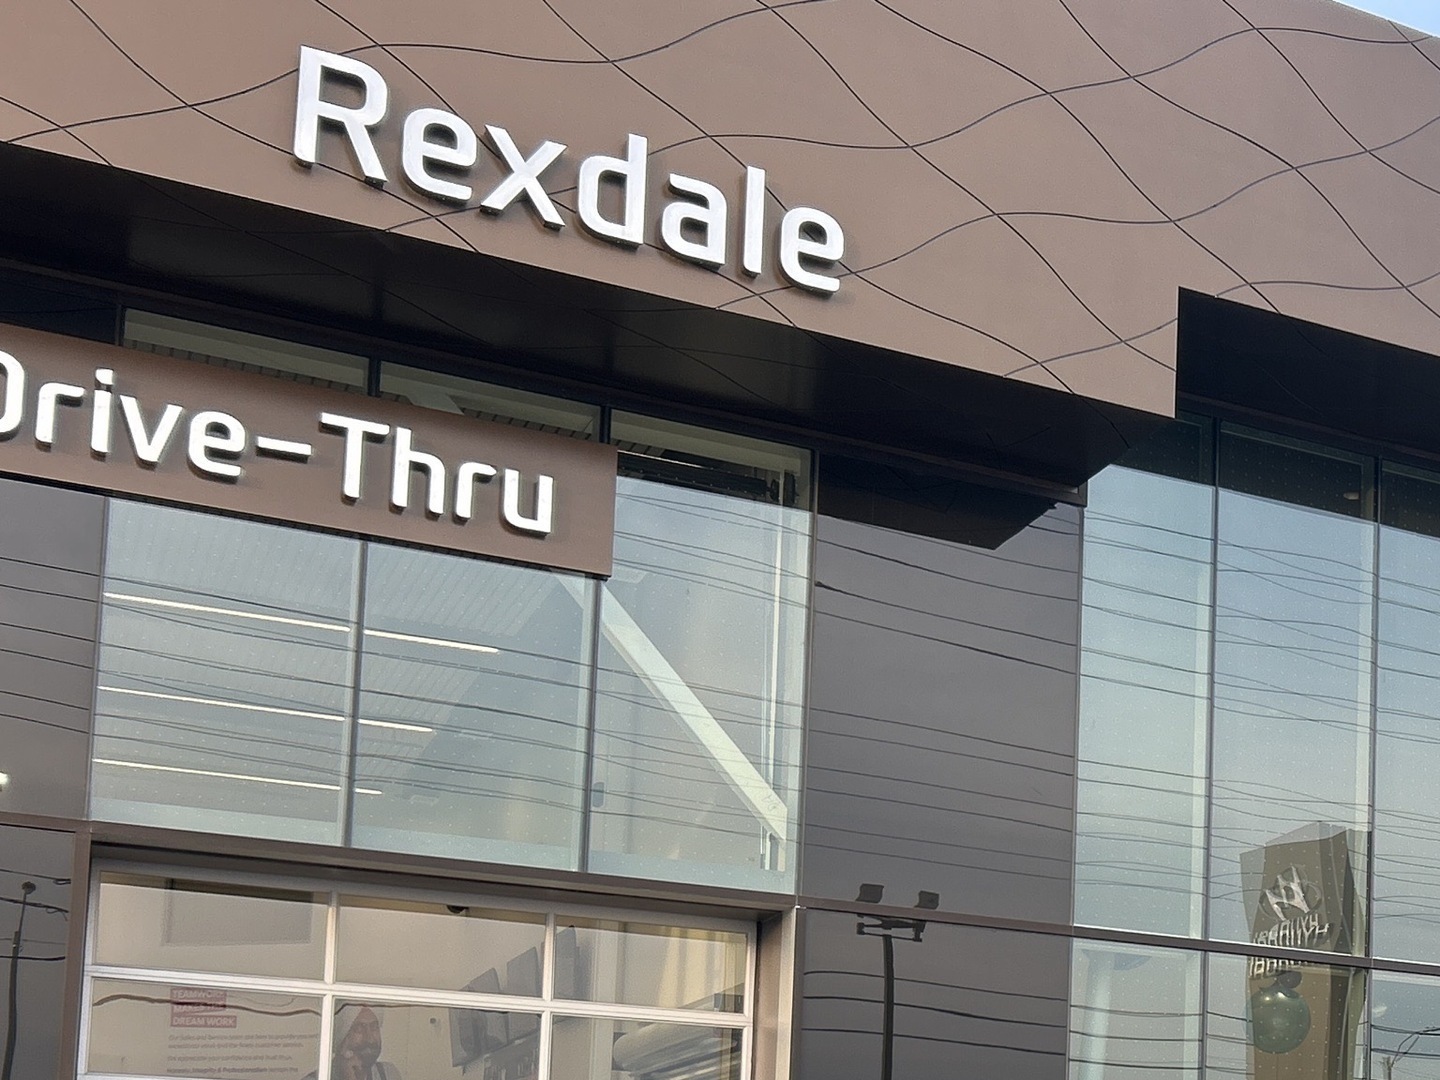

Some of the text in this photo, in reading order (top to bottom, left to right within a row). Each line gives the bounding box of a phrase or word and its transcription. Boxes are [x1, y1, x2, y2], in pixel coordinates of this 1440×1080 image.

[292, 44, 845, 296] Rexdale
[172, 1016, 236, 1026] DREAM WORK
